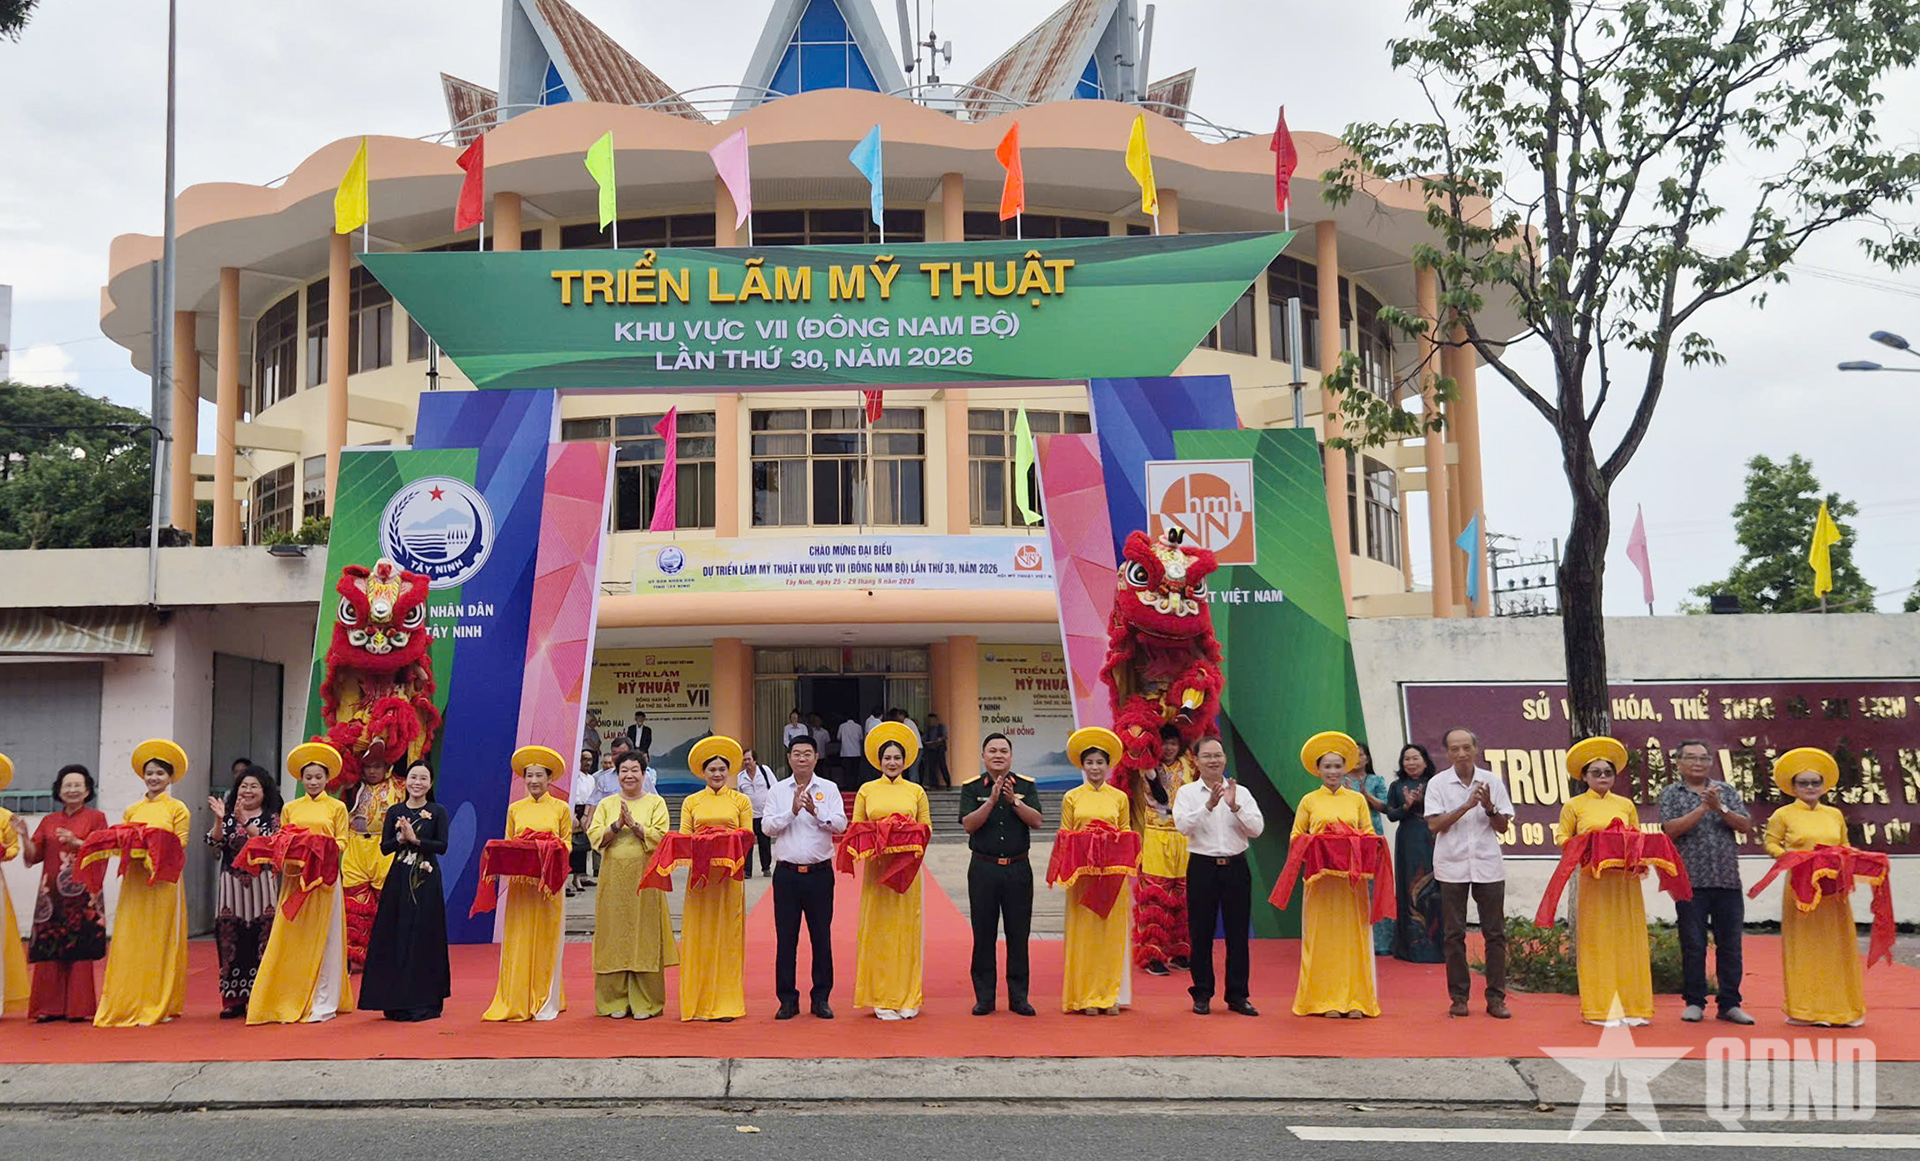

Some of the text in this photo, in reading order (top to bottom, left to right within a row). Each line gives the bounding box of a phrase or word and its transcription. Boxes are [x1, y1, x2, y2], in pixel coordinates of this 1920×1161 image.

[551, 249, 1075, 307] TRIỂN LÃM MỸ THUẬT
[614, 310, 1020, 345] KHU VỰC VII (ĐÔNG NAM BỘ)
[656, 341, 973, 371] LẦN THỨ 30, NĂM 2026
[809, 541, 892, 558] CHÀO MỪNG ĐẠI BIỂU
[411, 559, 464, 574] TÂY NINH
[703, 559, 998, 579] DỰ TRIỂN LÃM MỸ THUẬT KHU VỰC VII (ĐÔNG NAM BỘ) LẦN THỨ 30, NĂM 2026
[1221, 587, 1250, 605] VIỆT
[1254, 590, 1283, 602] NAM
[430, 601, 494, 617] NHÂN DÂN
[425, 623, 482, 638] TÂY NINH
[614, 669, 679, 678] TRIỂN LÃM
[618, 678, 680, 695] MỸ THUẬT
[1016, 676, 1033, 690] MỸ
[687, 689, 709, 707] VII
[1522, 690, 1550, 721] SỞ
[1612, 693, 1662, 722] HÓA,
[1670, 688, 1710, 720] THỂ
[1521, 822, 1544, 846] 09
